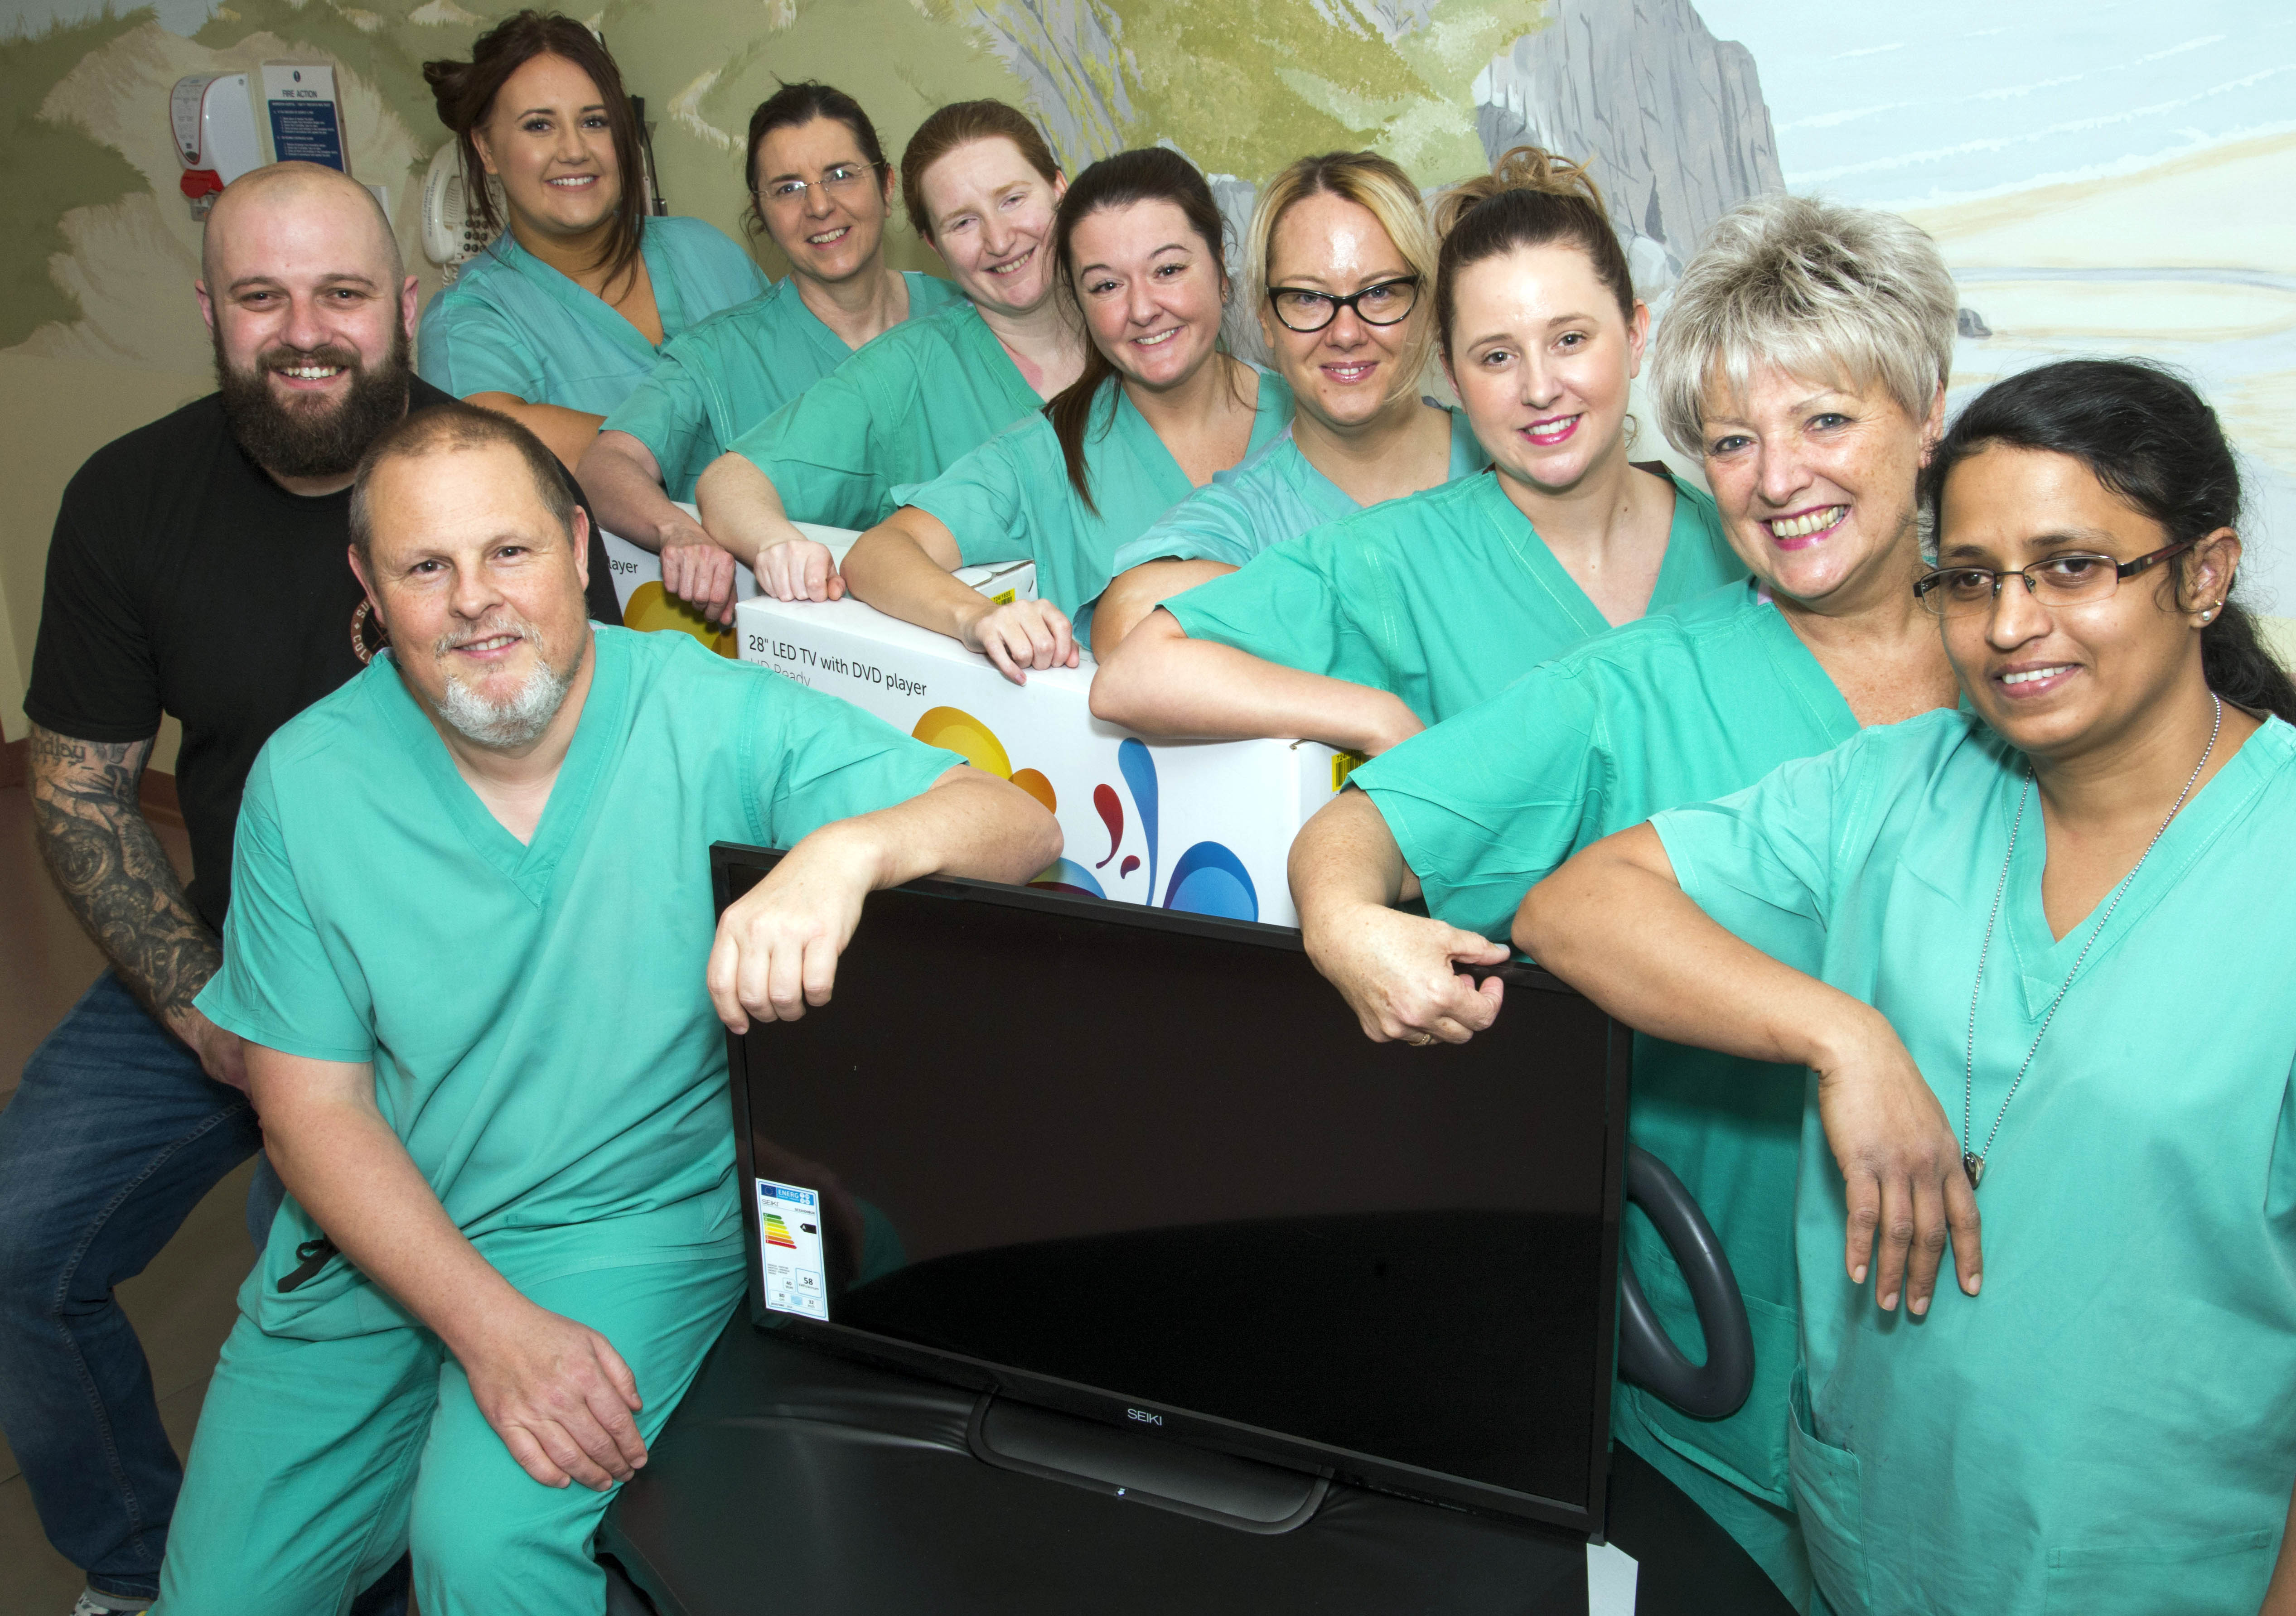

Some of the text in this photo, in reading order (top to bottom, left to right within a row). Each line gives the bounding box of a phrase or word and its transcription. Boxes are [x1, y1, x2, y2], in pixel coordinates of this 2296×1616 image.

[609, 555, 638, 574] layer
[357, 601, 370, 618] SU
[749, 635, 927, 696] 28" LED TV with DVD player
[778, 1189, 799, 1199] ENERG
[804, 1277, 813, 1285] 58
[1127, 1409, 1162, 1426] SEIKI
